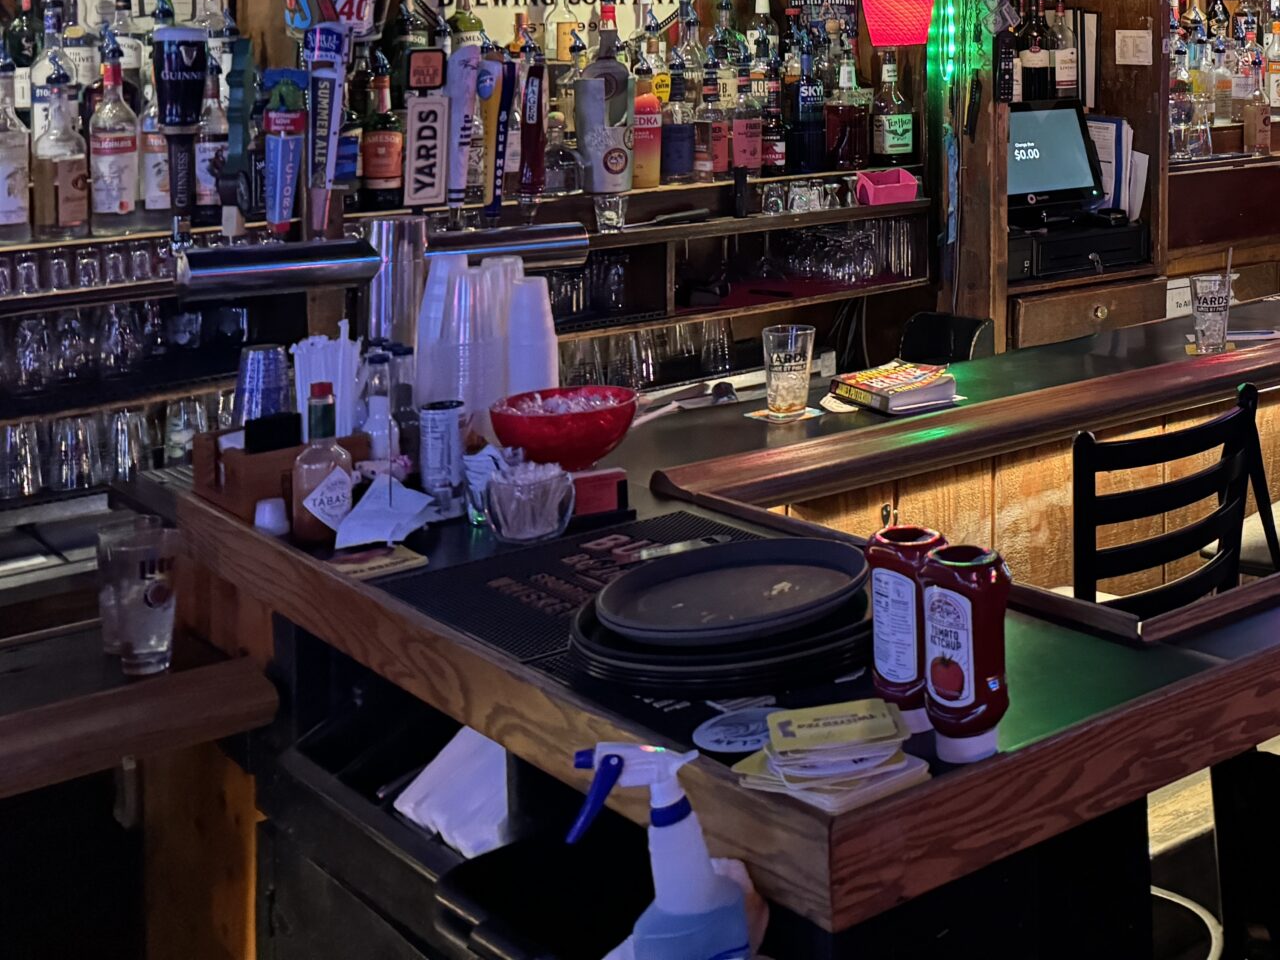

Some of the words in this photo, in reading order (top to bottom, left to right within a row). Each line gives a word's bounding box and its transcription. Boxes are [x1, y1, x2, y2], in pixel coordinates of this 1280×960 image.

[315, 80, 330, 138] SUMMER
[527, 78, 540, 122] LAGER
[314, 140, 328, 164] ALE
[413, 109, 438, 195] YARDS
[1014, 148, 1041, 161] $0.00
[175, 152, 188, 207] GUINNESS
[282, 139, 297, 220] VICTORY
[496, 159, 504, 196] MOON
[1196, 295, 1229, 306] YARDS
[768, 353, 807, 364] YARDS
